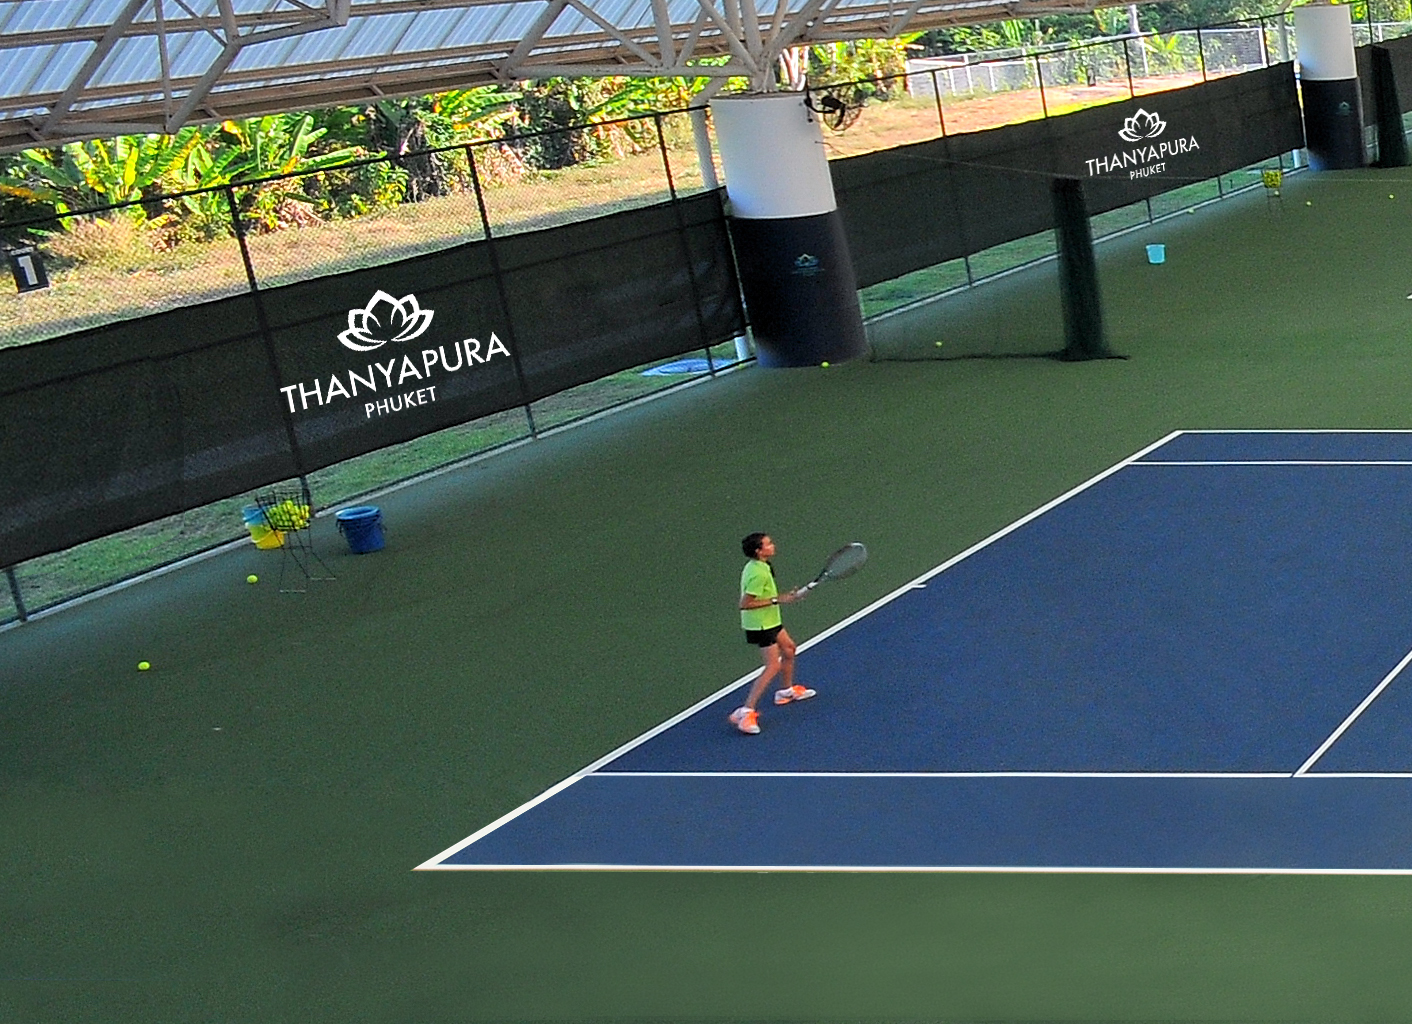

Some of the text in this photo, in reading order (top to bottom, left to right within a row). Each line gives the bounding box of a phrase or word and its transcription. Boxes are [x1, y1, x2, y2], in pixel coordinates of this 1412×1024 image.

[1085, 135, 1200, 177] THANYAPURA
[1129, 162, 1166, 180] PHUKET
[17, 255, 38, 286] 1
[279, 331, 511, 414] THANYAPURA
[364, 385, 437, 419] PHUKET
